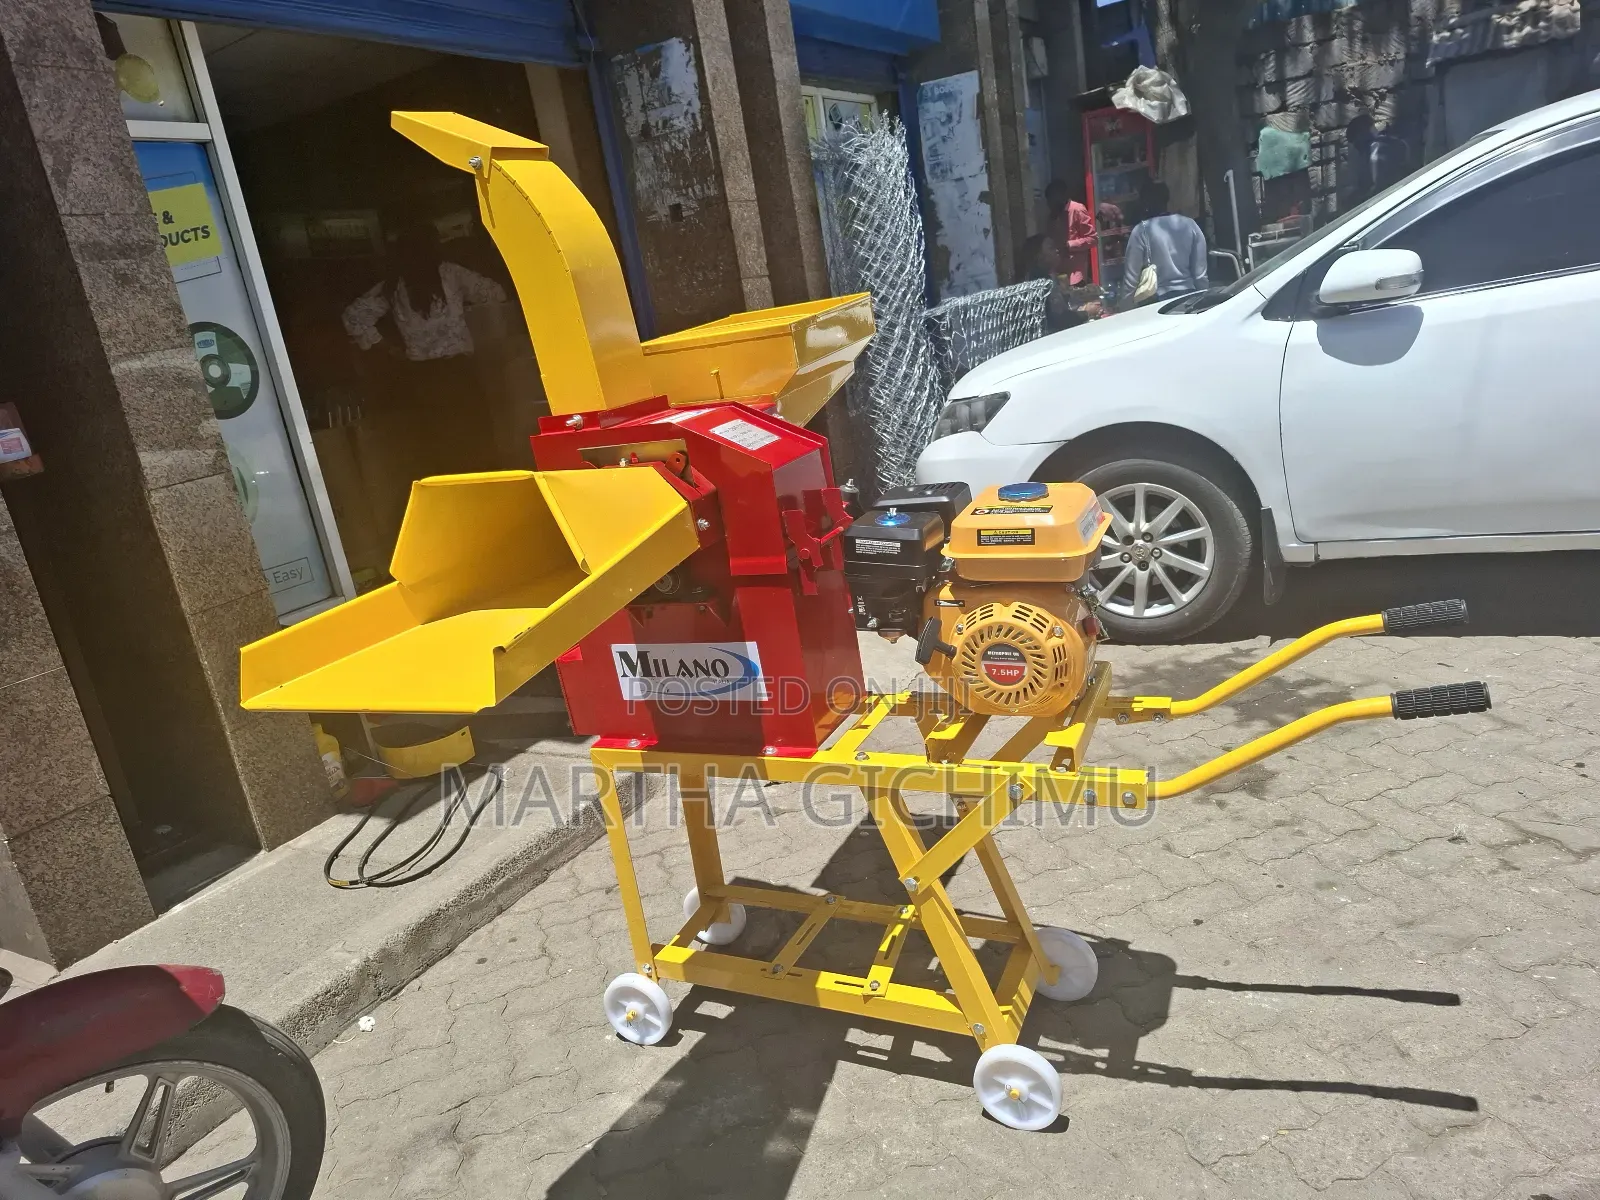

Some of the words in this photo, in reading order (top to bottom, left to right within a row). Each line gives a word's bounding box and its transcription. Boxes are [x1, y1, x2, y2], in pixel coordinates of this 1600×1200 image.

[162, 210, 175, 225] &
[160, 225, 211, 248] DUCTS
[272, 566, 303, 584] Easy
[615, 650, 735, 679] MILANO
[991, 668, 1020, 677] 7.5HP
